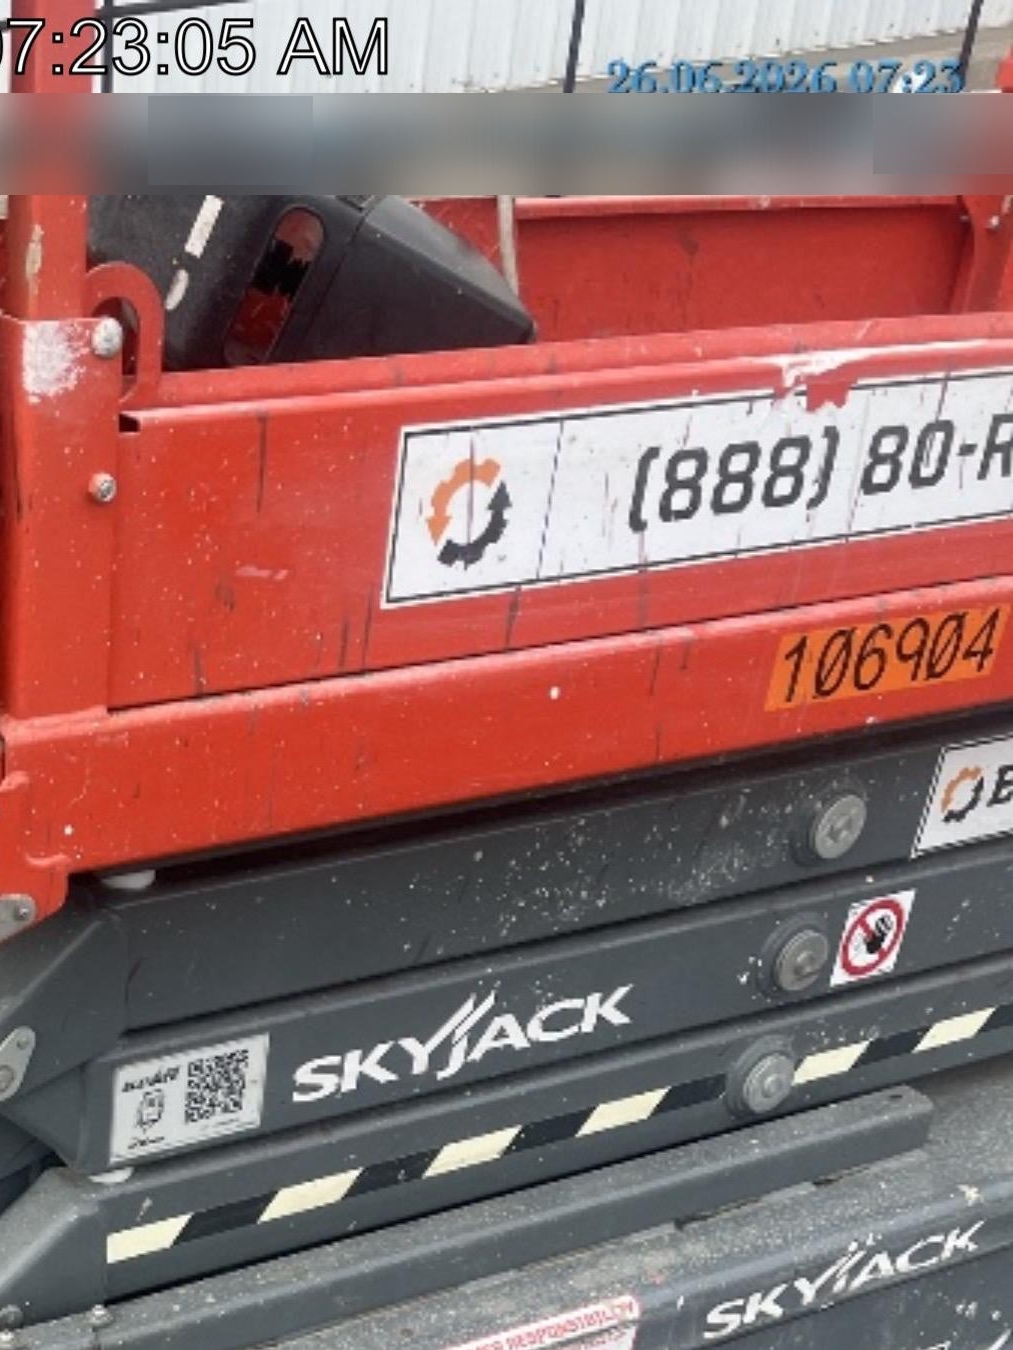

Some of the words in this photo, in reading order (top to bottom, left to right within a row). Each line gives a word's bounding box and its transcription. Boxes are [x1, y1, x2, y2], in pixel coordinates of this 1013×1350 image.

[628, 424, 839, 533] (888)
[784, 607, 1001, 703] 106904
[292, 983, 634, 1102] SKYJACK
[703, 1220, 985, 1339] SKYJACK
